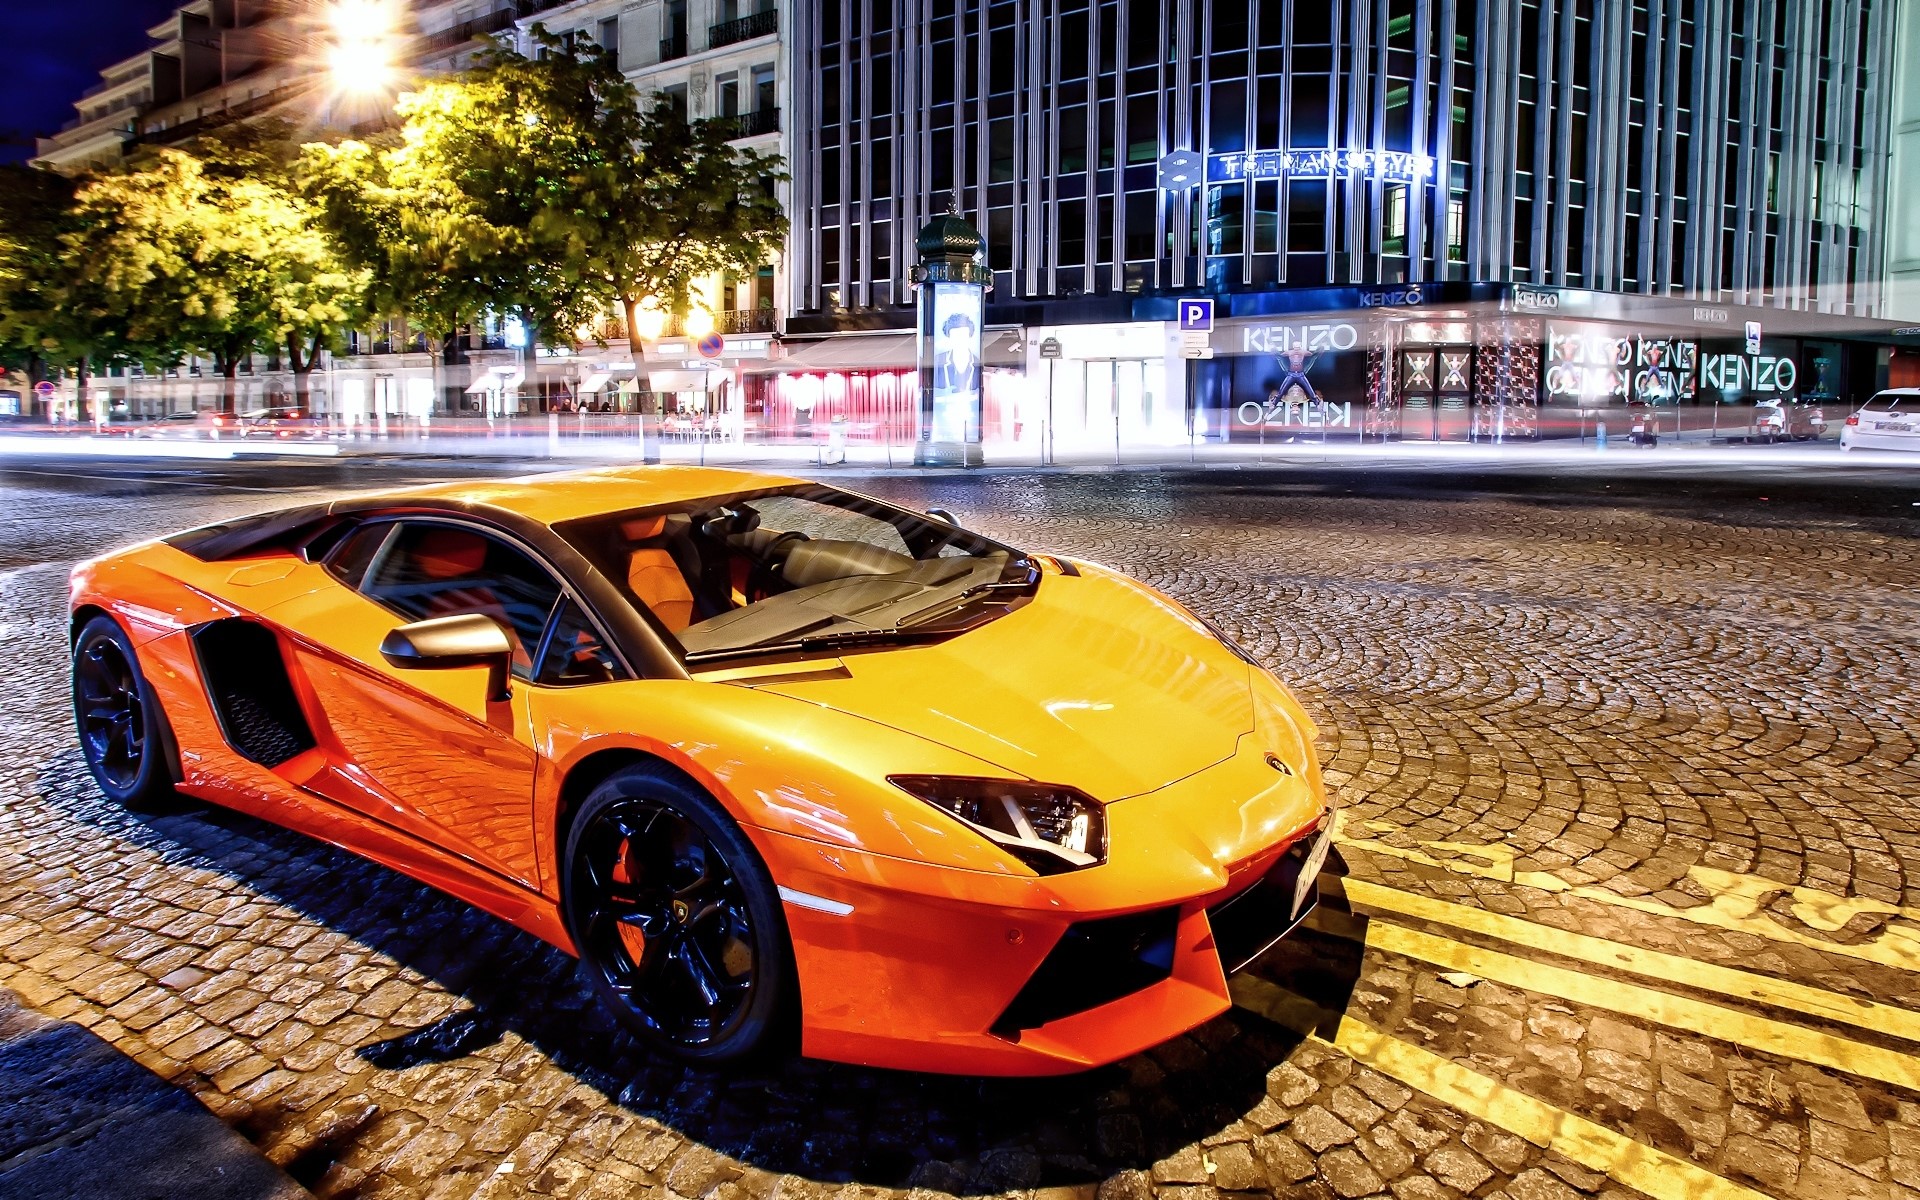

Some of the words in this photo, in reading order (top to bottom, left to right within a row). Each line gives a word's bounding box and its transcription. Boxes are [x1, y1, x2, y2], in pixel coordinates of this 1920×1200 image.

[1345, 152, 1433, 177] SPEYER
[1360, 291, 1421, 307] KENZO
[1515, 291, 1558, 308] KENZO
[1188, 305, 1203, 326] P
[1693, 307, 1728, 322] KENZO
[1243, 323, 1357, 352] KENZO
[1701, 353, 1796, 391] KENZO
